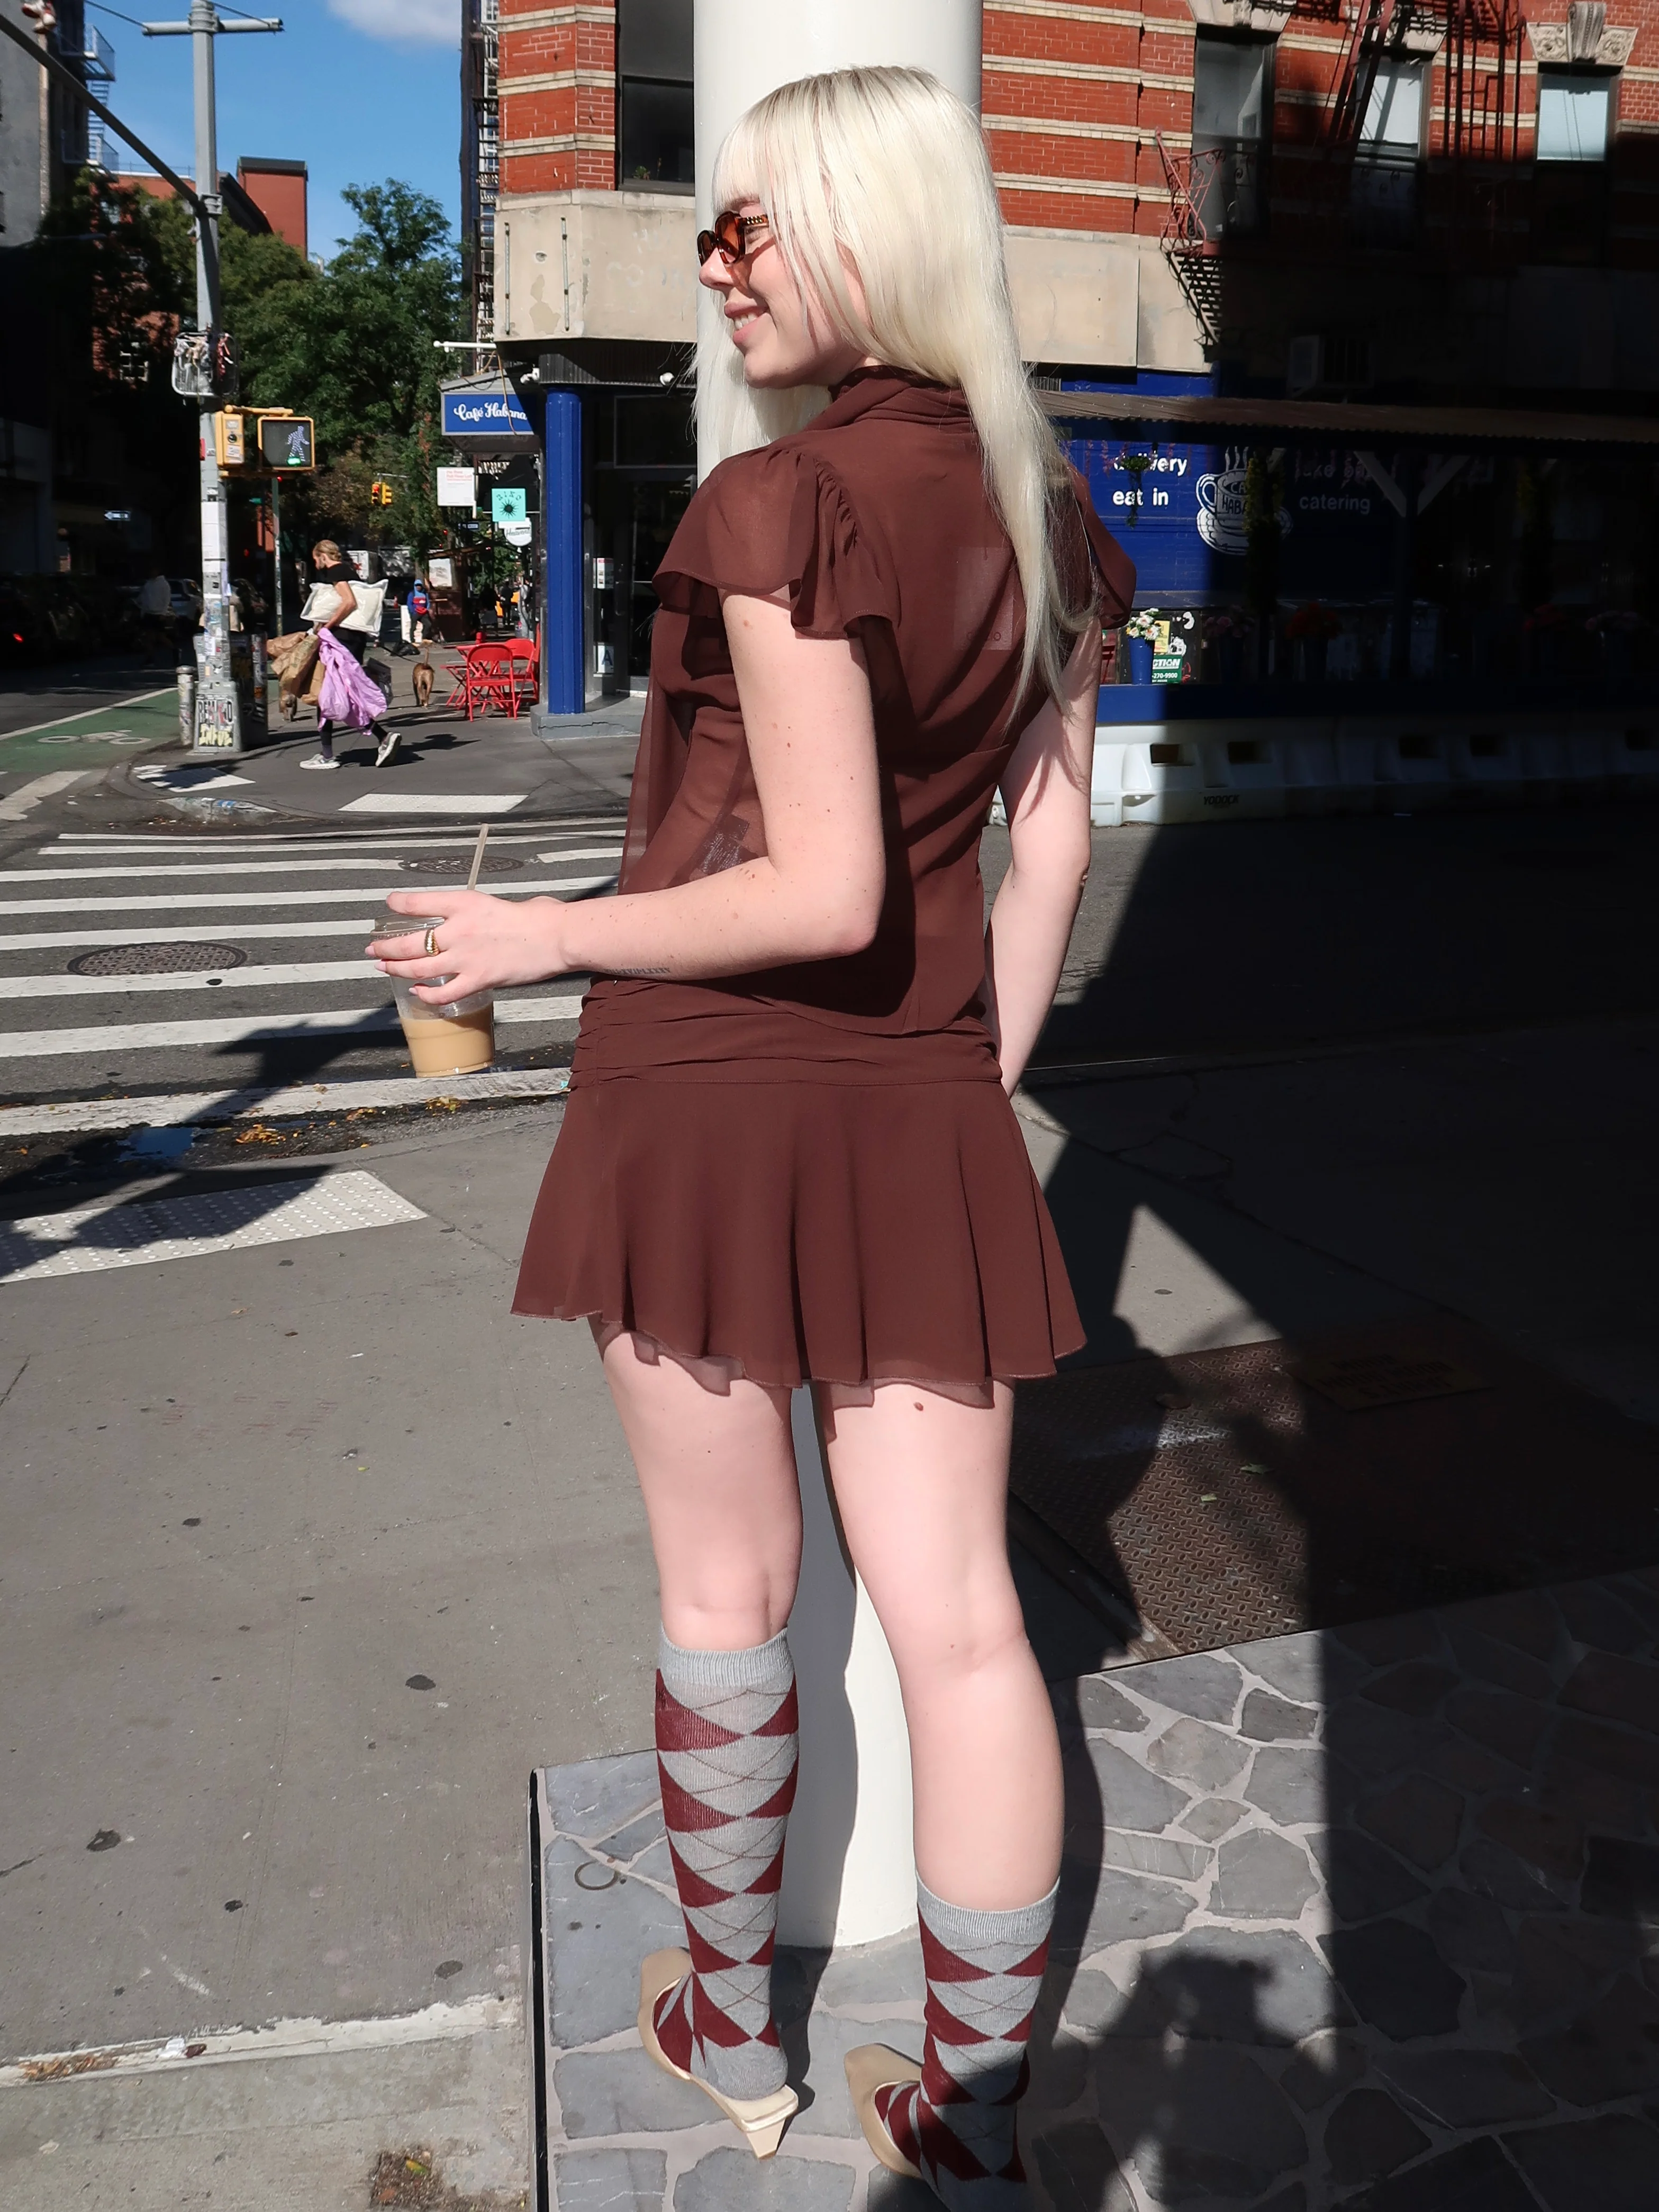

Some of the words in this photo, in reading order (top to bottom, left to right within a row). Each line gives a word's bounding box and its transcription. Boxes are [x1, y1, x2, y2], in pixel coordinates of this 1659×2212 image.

[453, 404, 484, 422] Café
[484, 402, 528, 421] Habana
[1112, 487, 1144, 506] eat
[1153, 487, 1169, 506] in
[1299, 494, 1371, 515] catering
[601, 649, 613, 666] A
[1153, 658, 1181, 667] CTION
